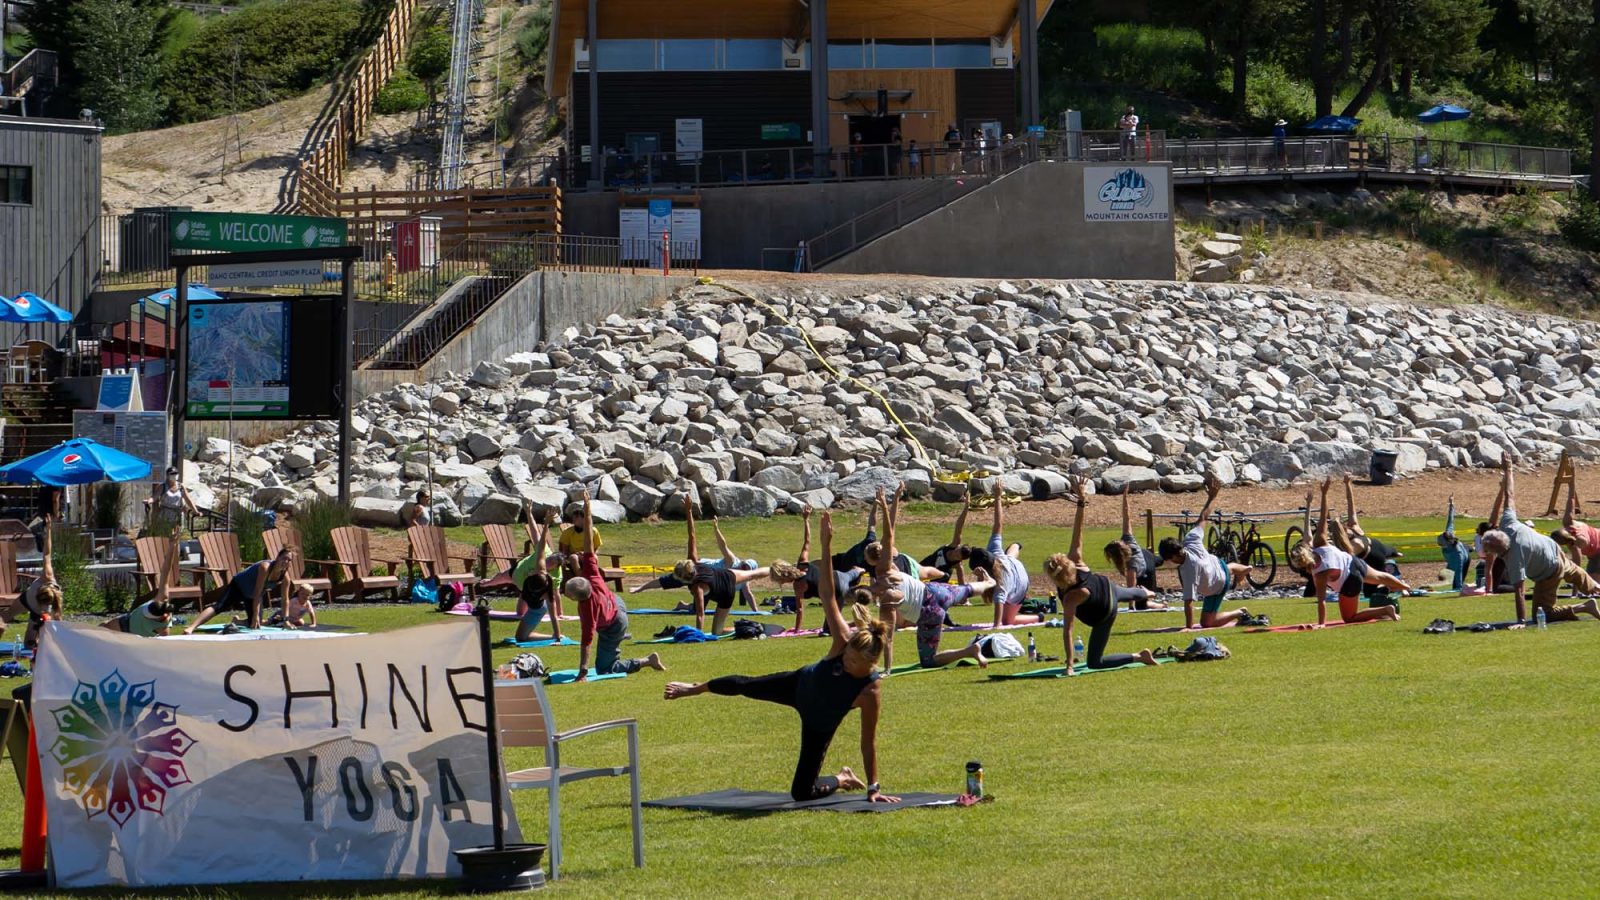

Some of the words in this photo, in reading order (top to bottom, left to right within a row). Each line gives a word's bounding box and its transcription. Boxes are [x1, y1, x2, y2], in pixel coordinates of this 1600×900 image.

[1086, 212, 1129, 220] MOUNTAIN
[1132, 212, 1168, 220] COASTER
[219, 222, 293, 244] WELCOME
[319, 227, 335, 236] Idaho
[319, 234, 341, 244] Central
[229, 271, 255, 279] CENTRAL
[257, 270, 279, 278] CREDIT
[280, 269, 300, 277] UNION
[301, 268, 321, 276] PLAZA
[218, 663, 488, 733] SHINE
[284, 755, 472, 823] YOGA
